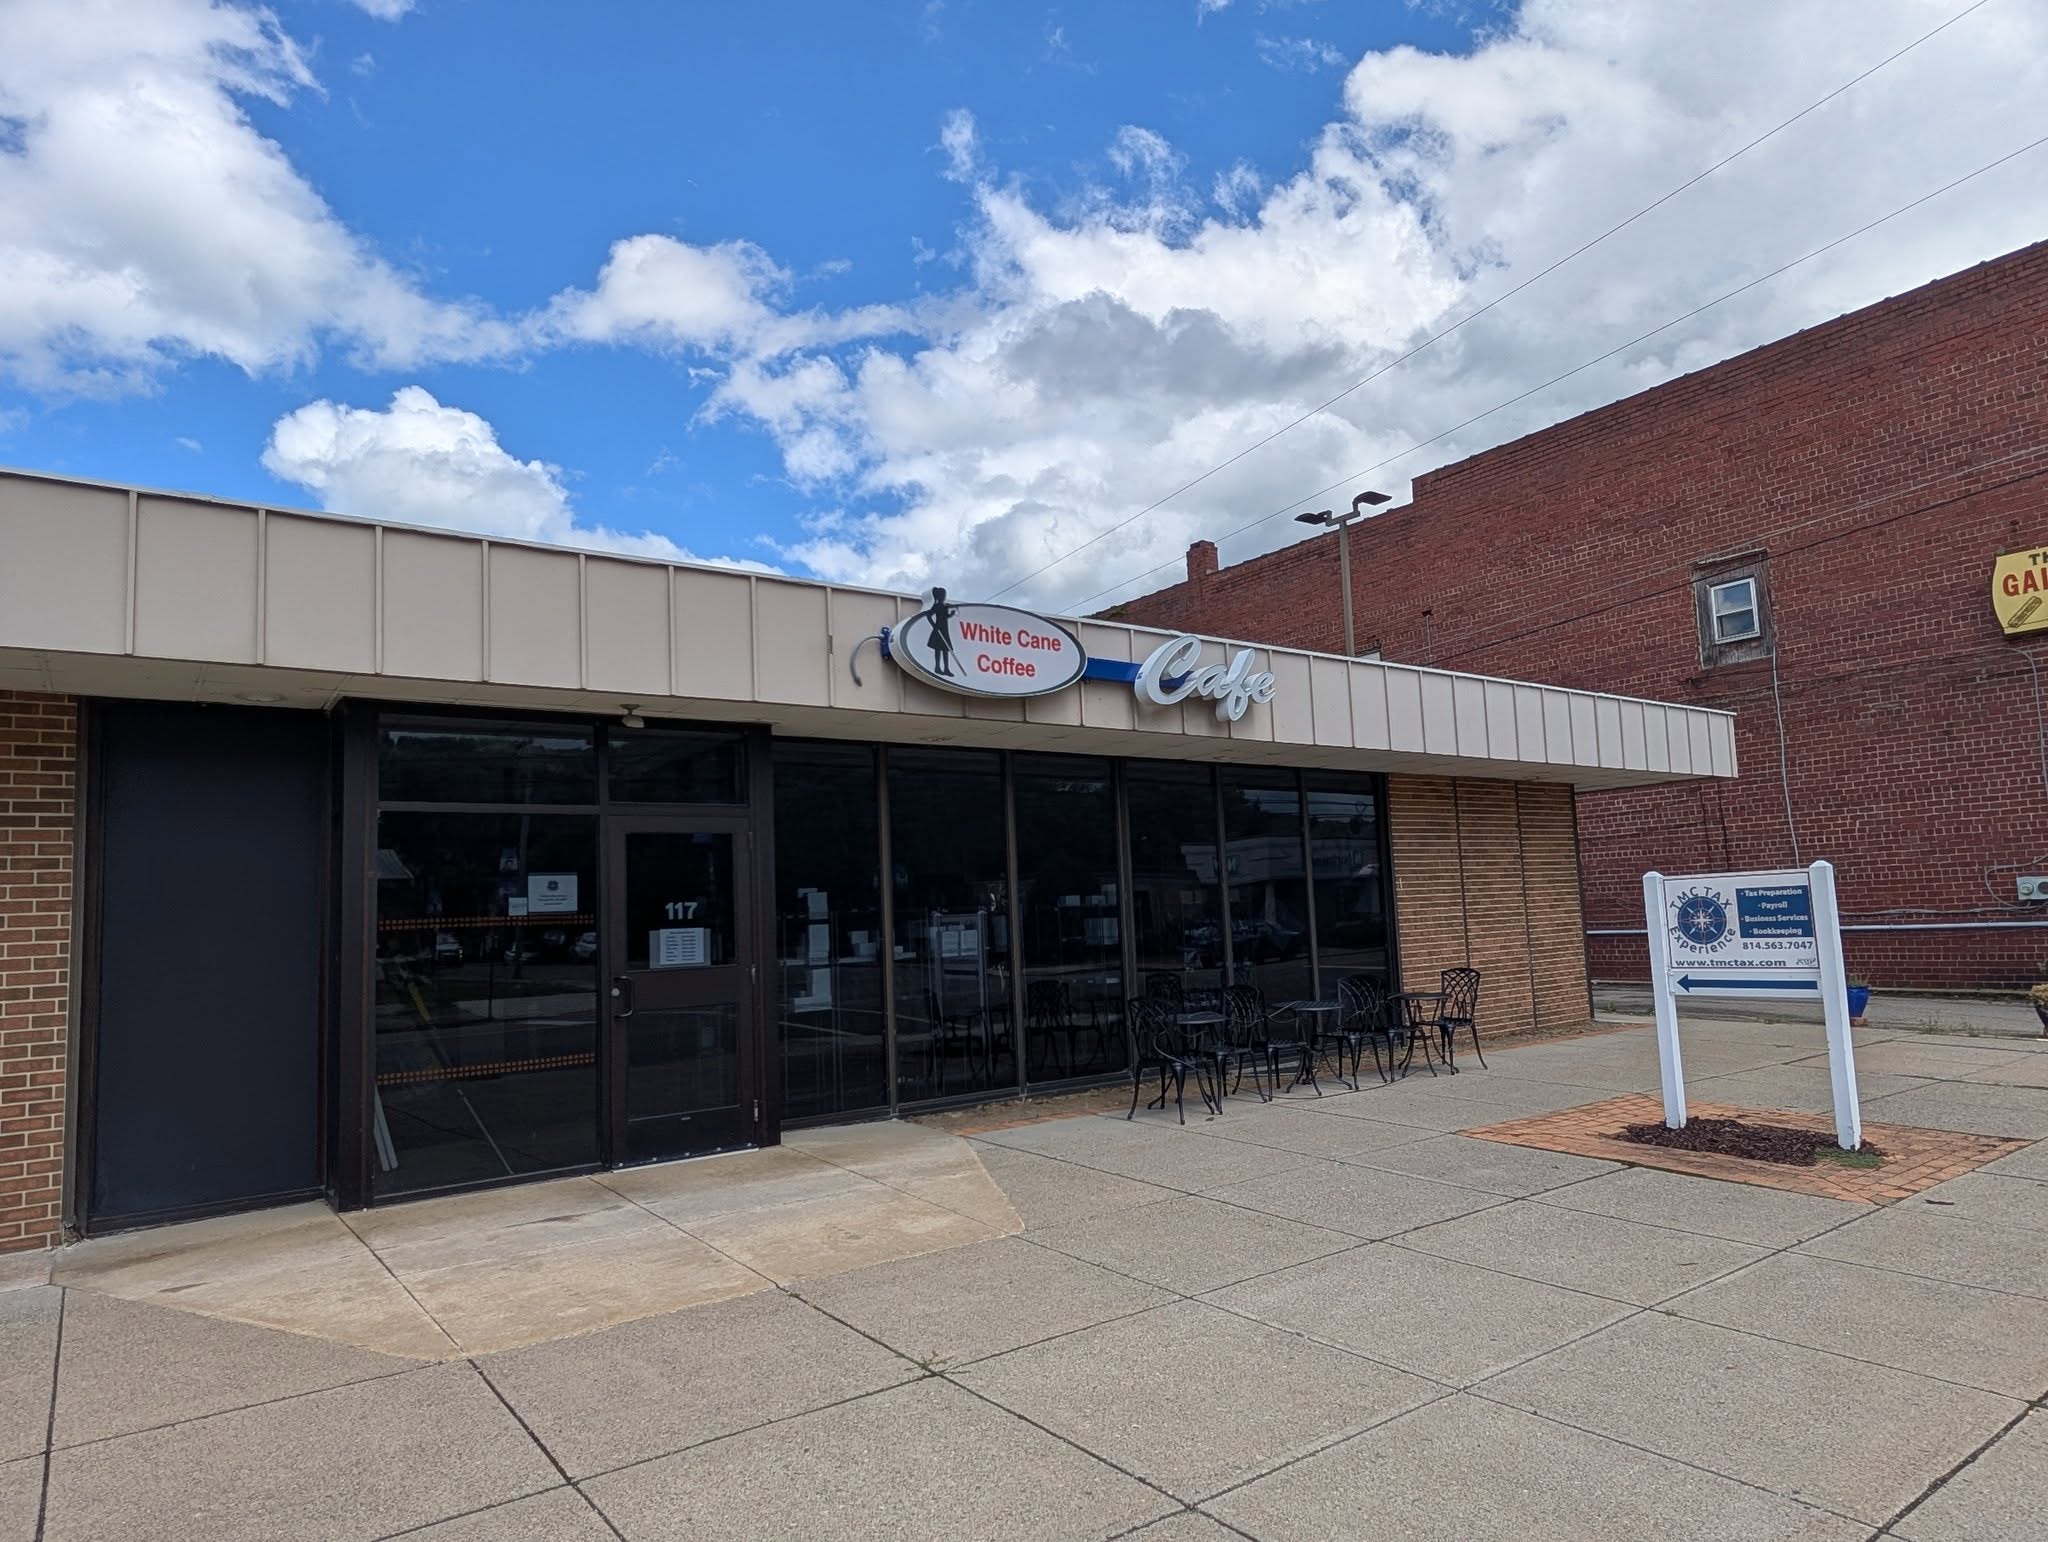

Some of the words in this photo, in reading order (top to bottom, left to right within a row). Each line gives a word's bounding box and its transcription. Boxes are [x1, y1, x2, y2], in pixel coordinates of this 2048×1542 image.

[959, 620, 1012, 646] White
[1017, 629, 1062, 653] Cane
[976, 654, 1036, 678] Coffee
[1134, 634, 1277, 722] Cafe
[1669, 886, 1700, 910] TMC
[1703, 886, 1733, 910] TAX
[1759, 888, 1803, 897] Preparation
[665, 901, 698, 920] 117
[1761, 901, 1788, 910] Payroll
[1777, 914, 1809, 922] Services
[1752, 926, 1802, 935] Bookkeeping
[1669, 926, 1736, 954] Experience
[1742, 941, 1813, 950] 814.563.7047
[1675, 958, 1787, 967] www.tmctax.com
